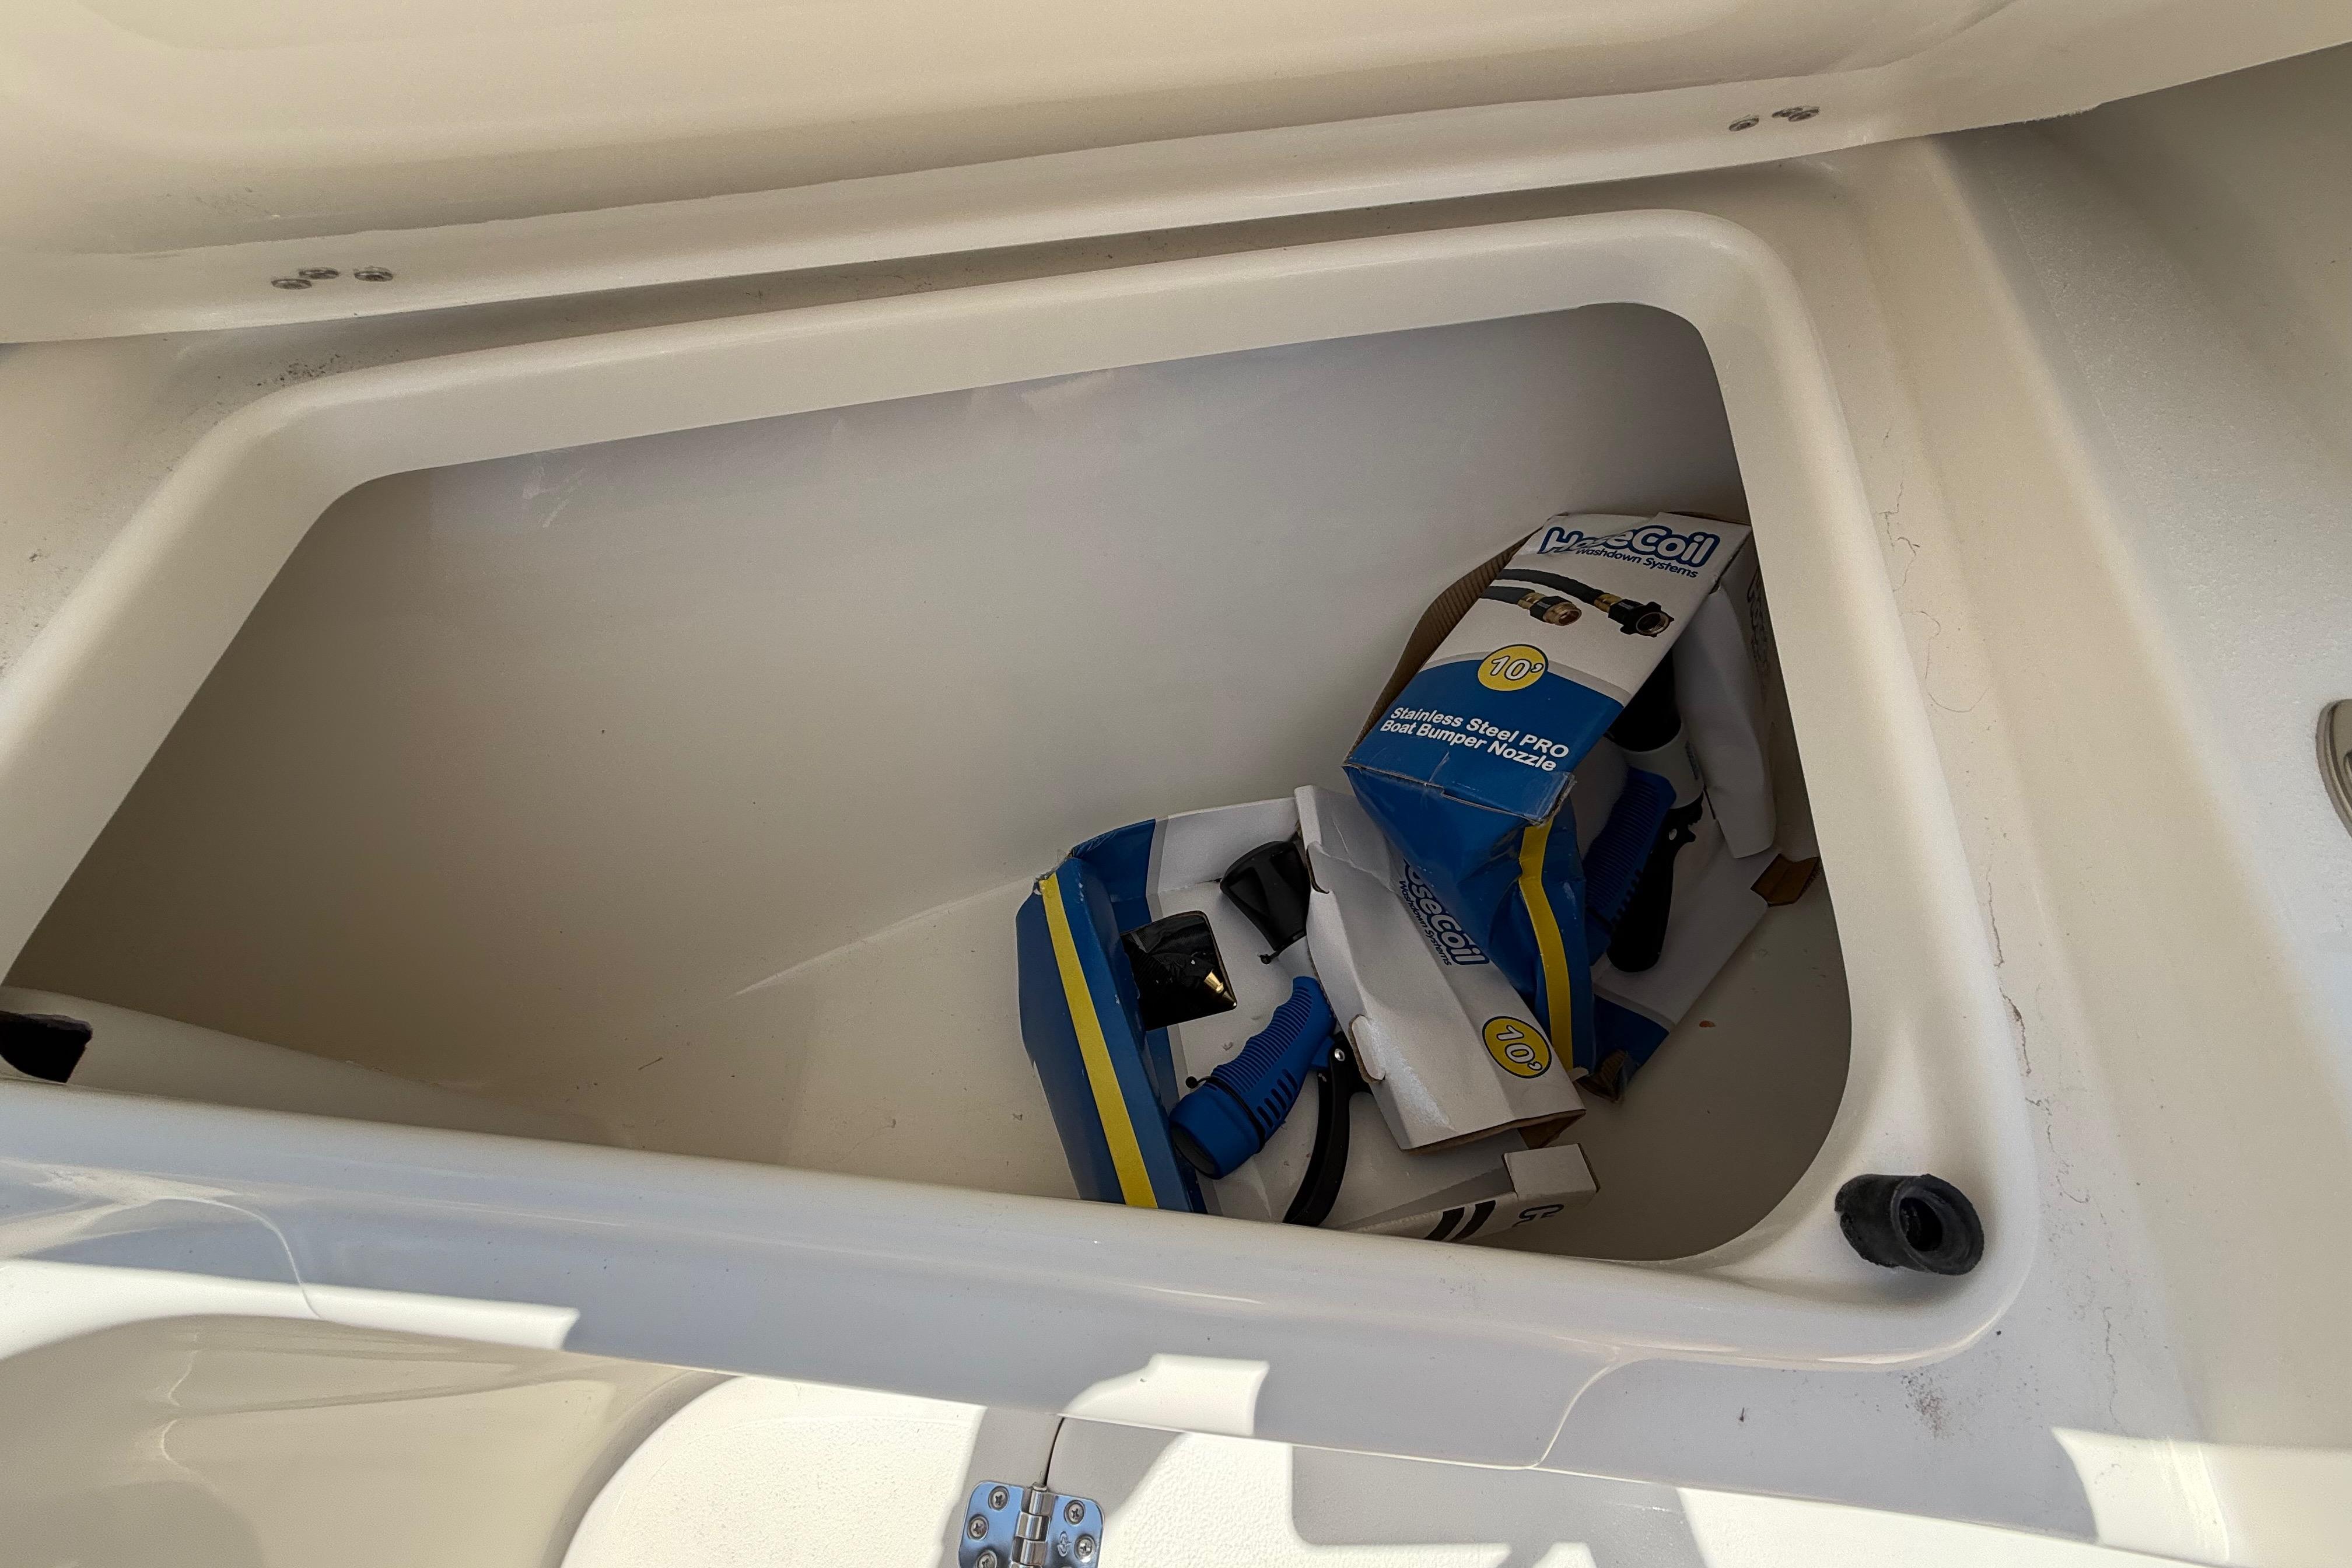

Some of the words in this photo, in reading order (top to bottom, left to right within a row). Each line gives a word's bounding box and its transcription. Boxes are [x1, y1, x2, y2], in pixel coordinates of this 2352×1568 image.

[1643, 557, 1698, 578] Systems
[1380, 720, 1417, 736] Boat
[1416, 724, 1487, 749] Bumper
[1487, 740, 1557, 771] Nozzle
[1391, 707, 1462, 727] Stainless
[1466, 718, 1519, 743] Steel
[1519, 734, 1570, 758] PRO
[1399, 880, 1428, 928] Washdown
[1424, 929, 1452, 966] Systems
[1403, 859, 1490, 965] oseCoil
